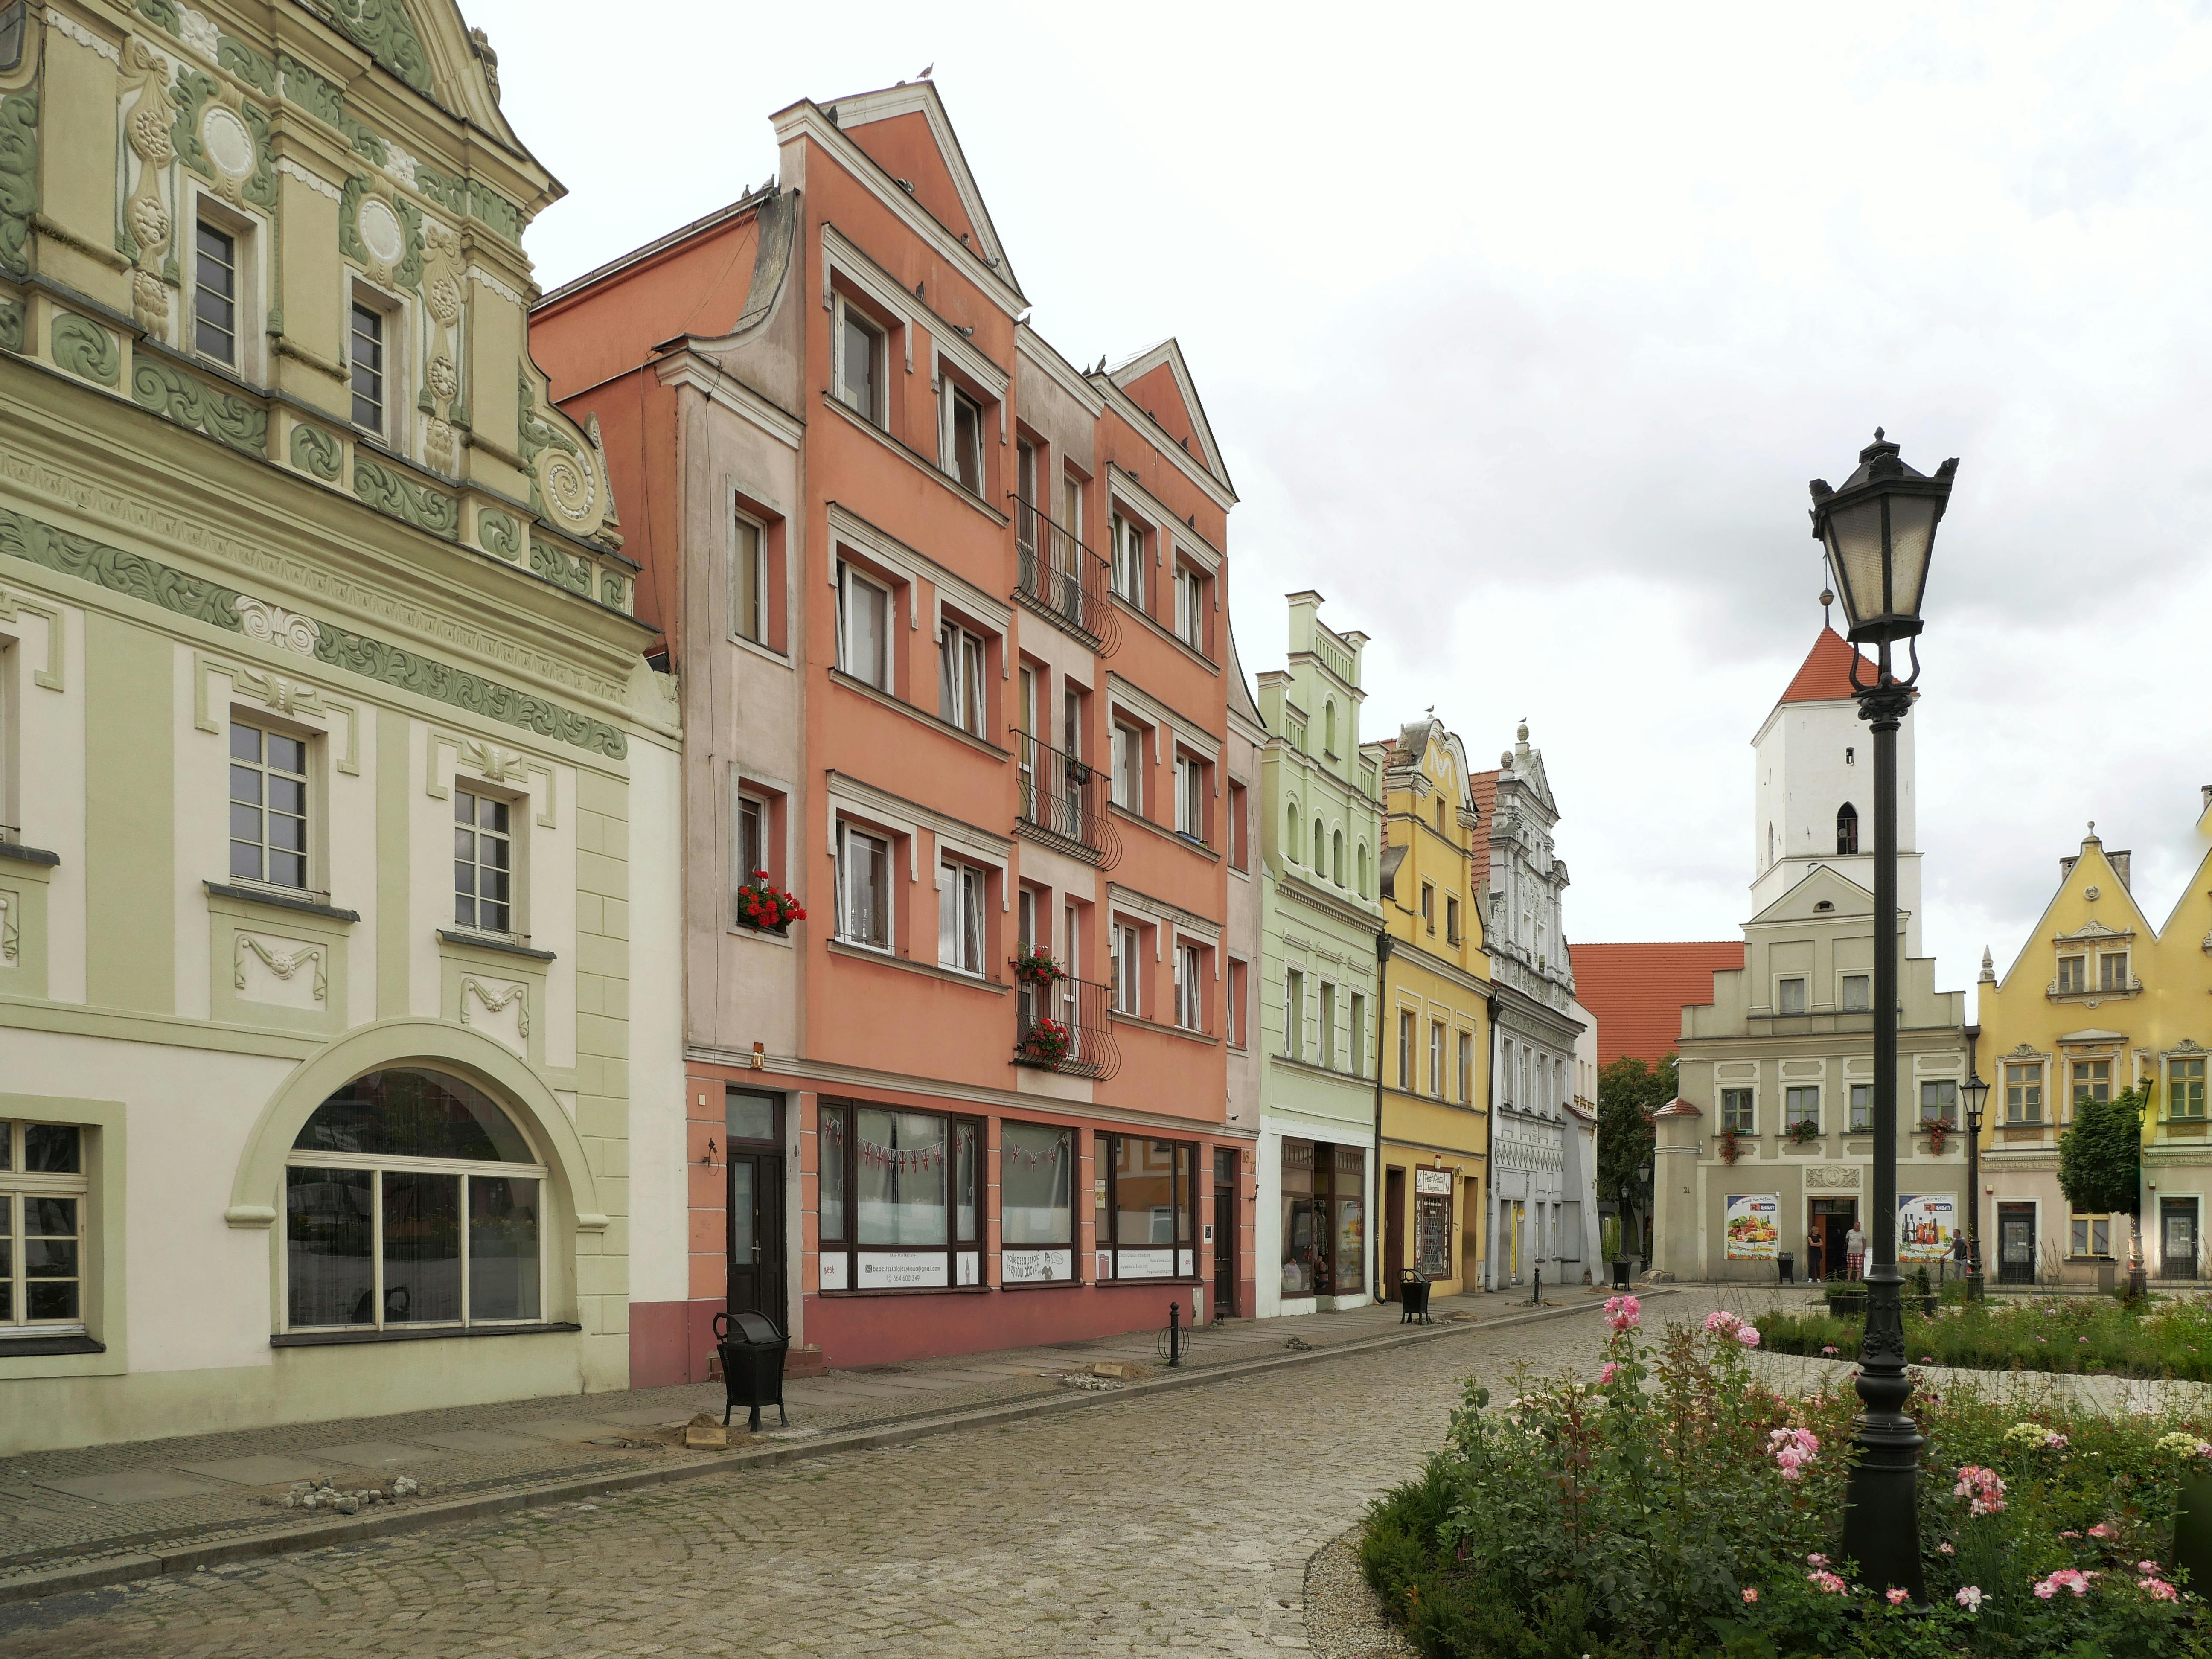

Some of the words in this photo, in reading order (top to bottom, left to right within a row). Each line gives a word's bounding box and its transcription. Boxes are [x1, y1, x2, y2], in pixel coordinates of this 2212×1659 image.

[1242, 1151, 1249, 1163] 16
[1250, 1161, 1256, 1173] 17
[1007, 1253, 1026, 1266] najlepsza
[1025, 1261, 1039, 1278] obcych
